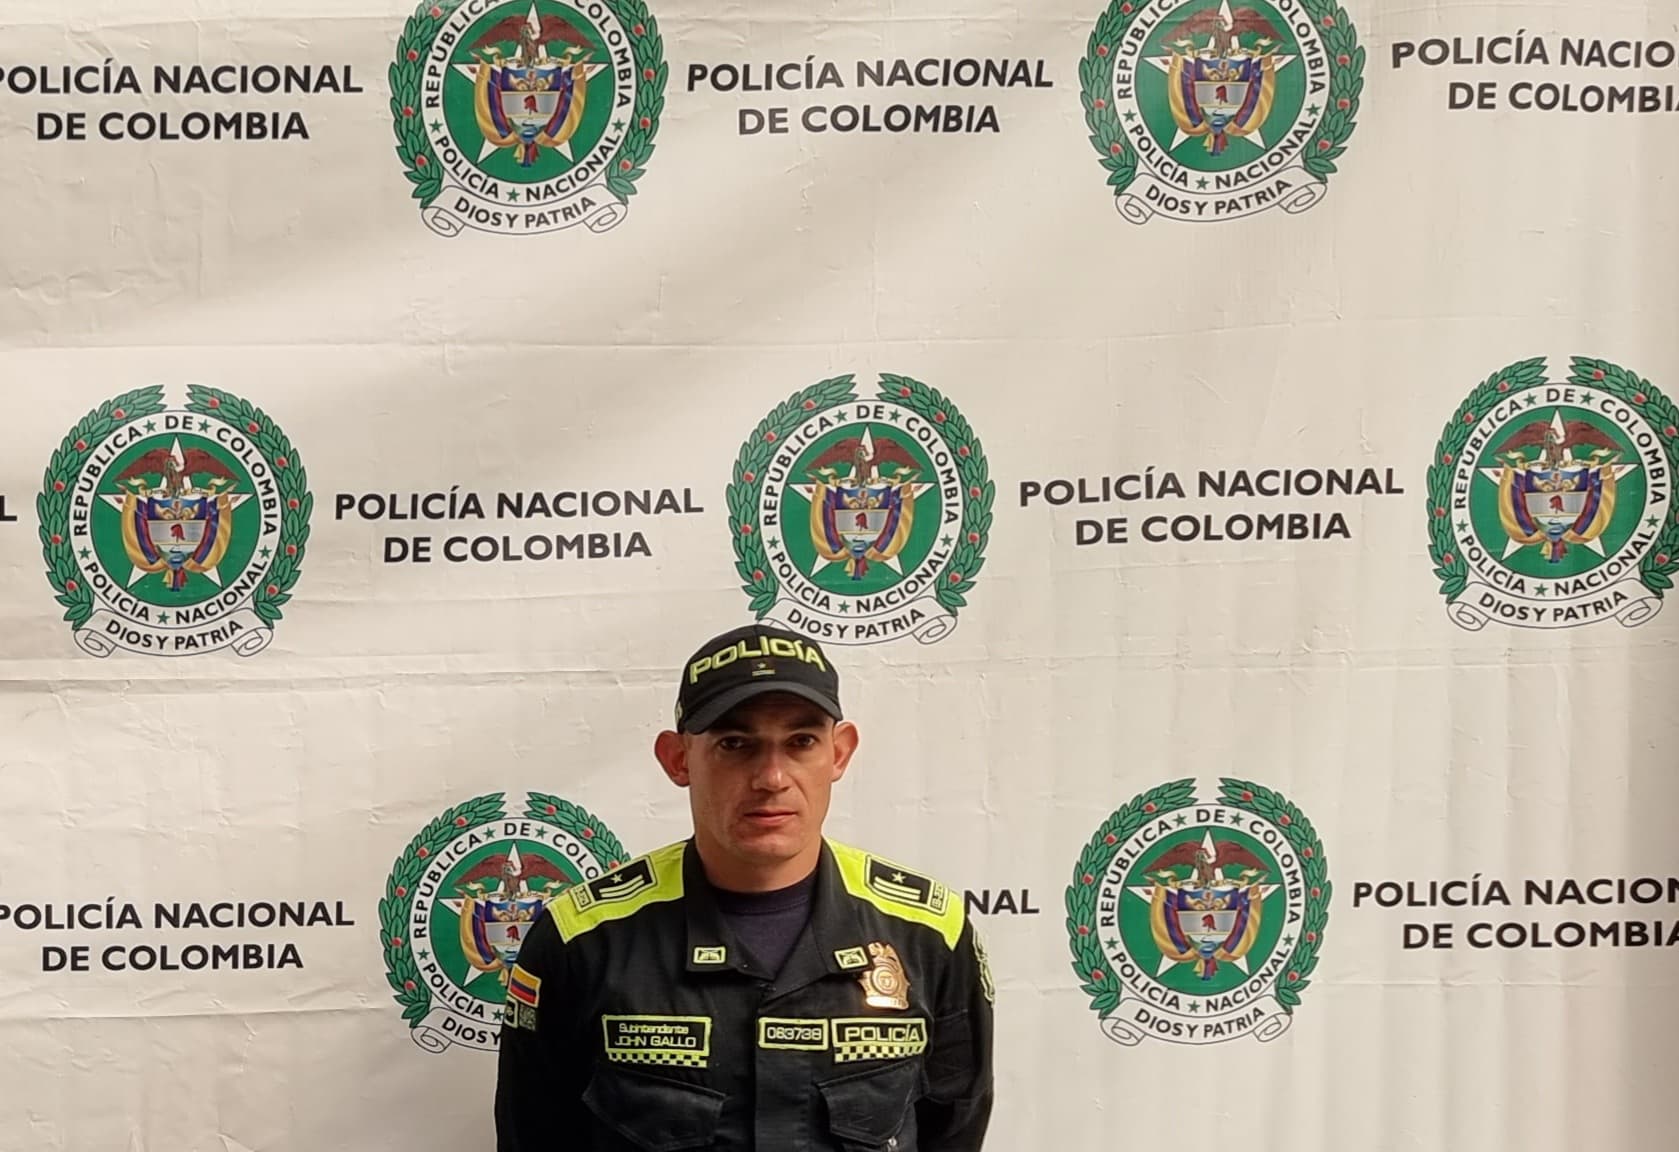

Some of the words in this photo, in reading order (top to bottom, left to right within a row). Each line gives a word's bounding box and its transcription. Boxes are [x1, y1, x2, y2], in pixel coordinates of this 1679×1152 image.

[1391, 36, 1550, 69] POLICÍA
[1561, 38, 1679, 68] NACIO
[154, 64, 364, 94] NACIONAL
[687, 55, 844, 92] POLICÍA
[857, 58, 1054, 88] NACIONAL
[1448, 81, 1497, 110] DE
[1509, 82, 1679, 112] COLOMBI
[37, 112, 86, 141] DE
[98, 111, 310, 141] COLOMBIA
[738, 107, 789, 135] DE
[801, 104, 1001, 133] COLOMBIA
[165, 416, 193, 430] DE
[217, 428, 276, 535] COLOMBIA
[1020, 465, 1186, 508] POLICÍA
[1198, 467, 1405, 498] NACIONAL
[335, 484, 486, 521] POLICÍA
[496, 487, 704, 519] NACIONAL
[1075, 517, 1128, 546] DE
[1141, 512, 1352, 543] COLOMBIA
[383, 536, 432, 563] DE
[443, 531, 652, 563] COLOMBIA
[176, 559, 266, 624] NACIONAL
[105, 620, 153, 648] DIOS
[175, 620, 243, 649] PATRIA
[689, 636, 826, 684] POLICÍA
[1196, 809, 1225, 823] DE
[1250, 821, 1301, 924] COLOMBIA
[1353, 873, 1511, 908] POLICÍA
[154, 900, 355, 929] NACIONAL
[1403, 923, 1453, 950] DE
[42, 945, 90, 972] DE
[101, 943, 304, 971] COLOMBIA
[1206, 949, 1290, 1012] NACIONAL
[845, 1025, 920, 1042] POLICÍA
[1134, 1009, 1184, 1036] DIOS
[1204, 1008, 1265, 1038] PATRIA
[650, 1036, 696, 1047] GALLO
